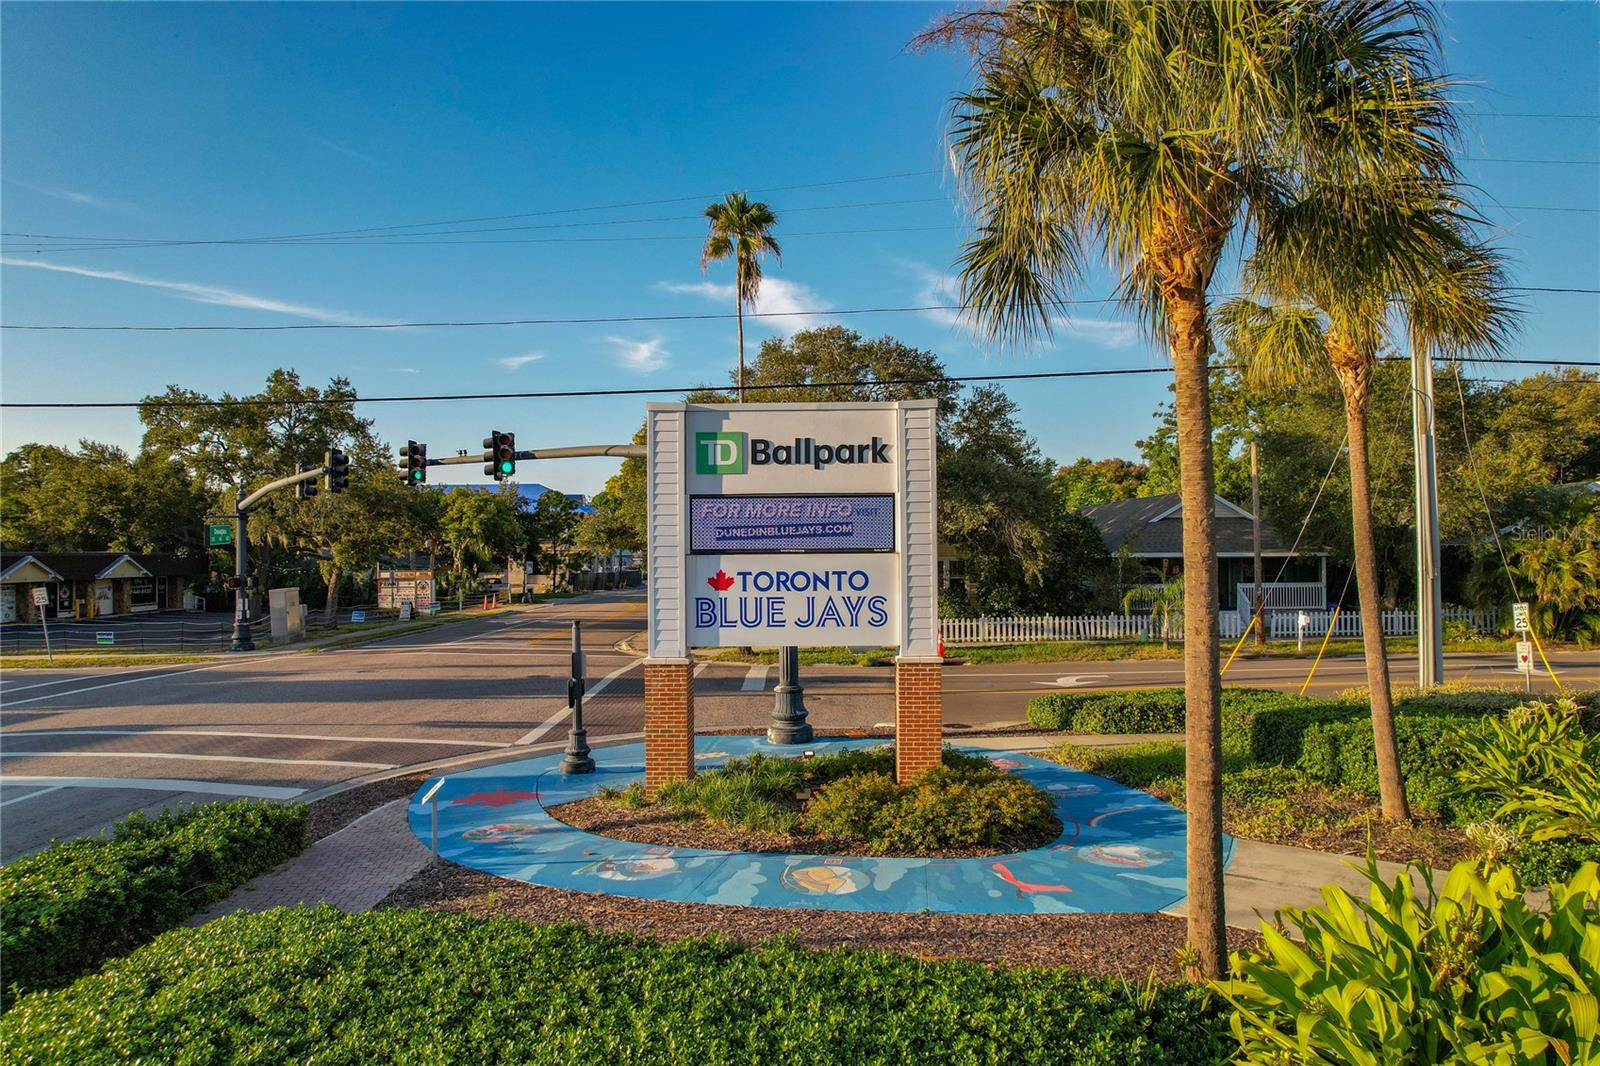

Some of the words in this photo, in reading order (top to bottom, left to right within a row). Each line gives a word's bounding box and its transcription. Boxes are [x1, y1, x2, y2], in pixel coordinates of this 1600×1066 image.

[700, 439, 738, 466] TD
[750, 437, 889, 470] Ballpark
[700, 503, 741, 519] FOR
[747, 502, 801, 519] MORE
[806, 502, 852, 519] INFO
[715, 523, 853, 540] DUNEDINBLUEJAYS.COM
[737, 570, 870, 592] TORONTO
[695, 596, 786, 628] BLUE
[794, 595, 888, 628] JAYS
[1515, 617, 1529, 629] 25
